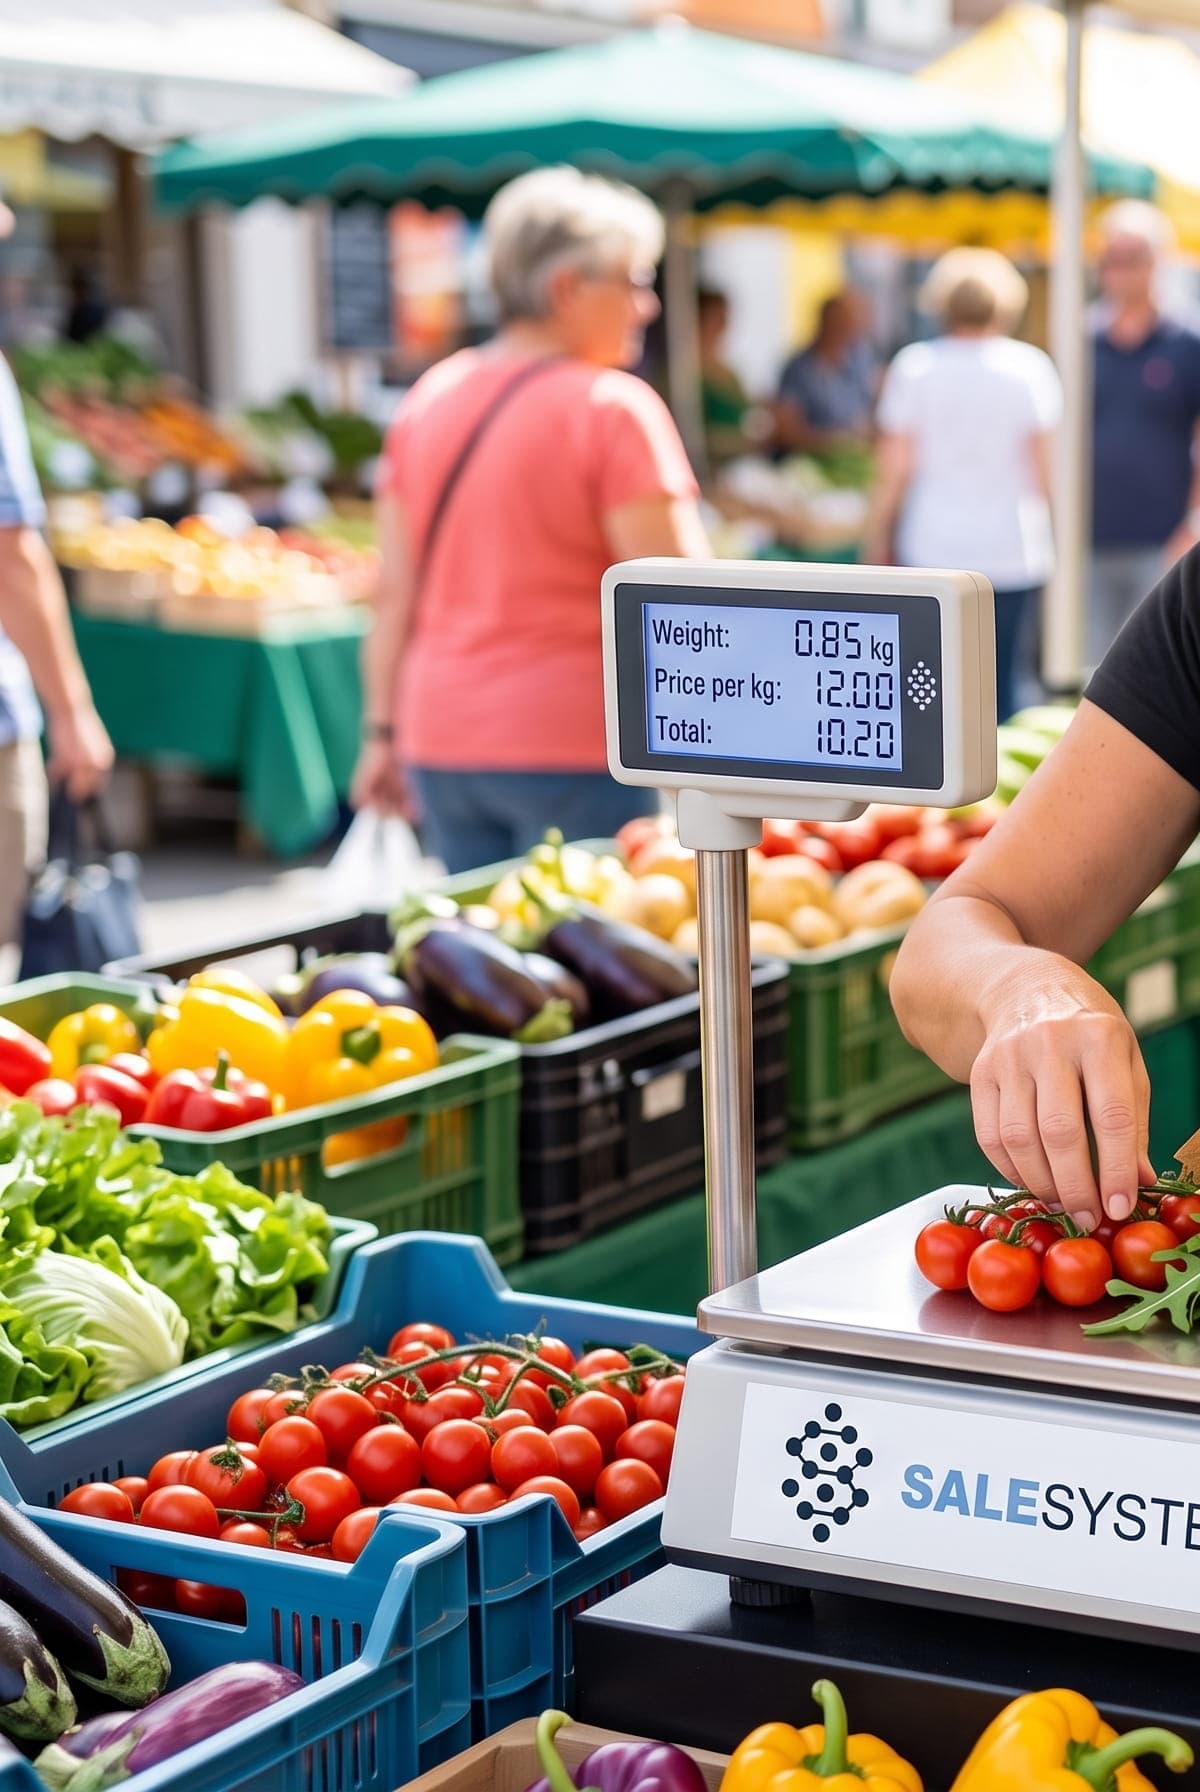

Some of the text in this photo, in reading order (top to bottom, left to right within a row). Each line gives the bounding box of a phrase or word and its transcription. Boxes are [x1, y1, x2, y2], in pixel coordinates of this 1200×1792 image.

[652, 619, 894, 666] Weight: 0.85 kg
[655, 669, 893, 711] Price per kg: 12.00
[655, 715, 894, 759] Total: 10.20
